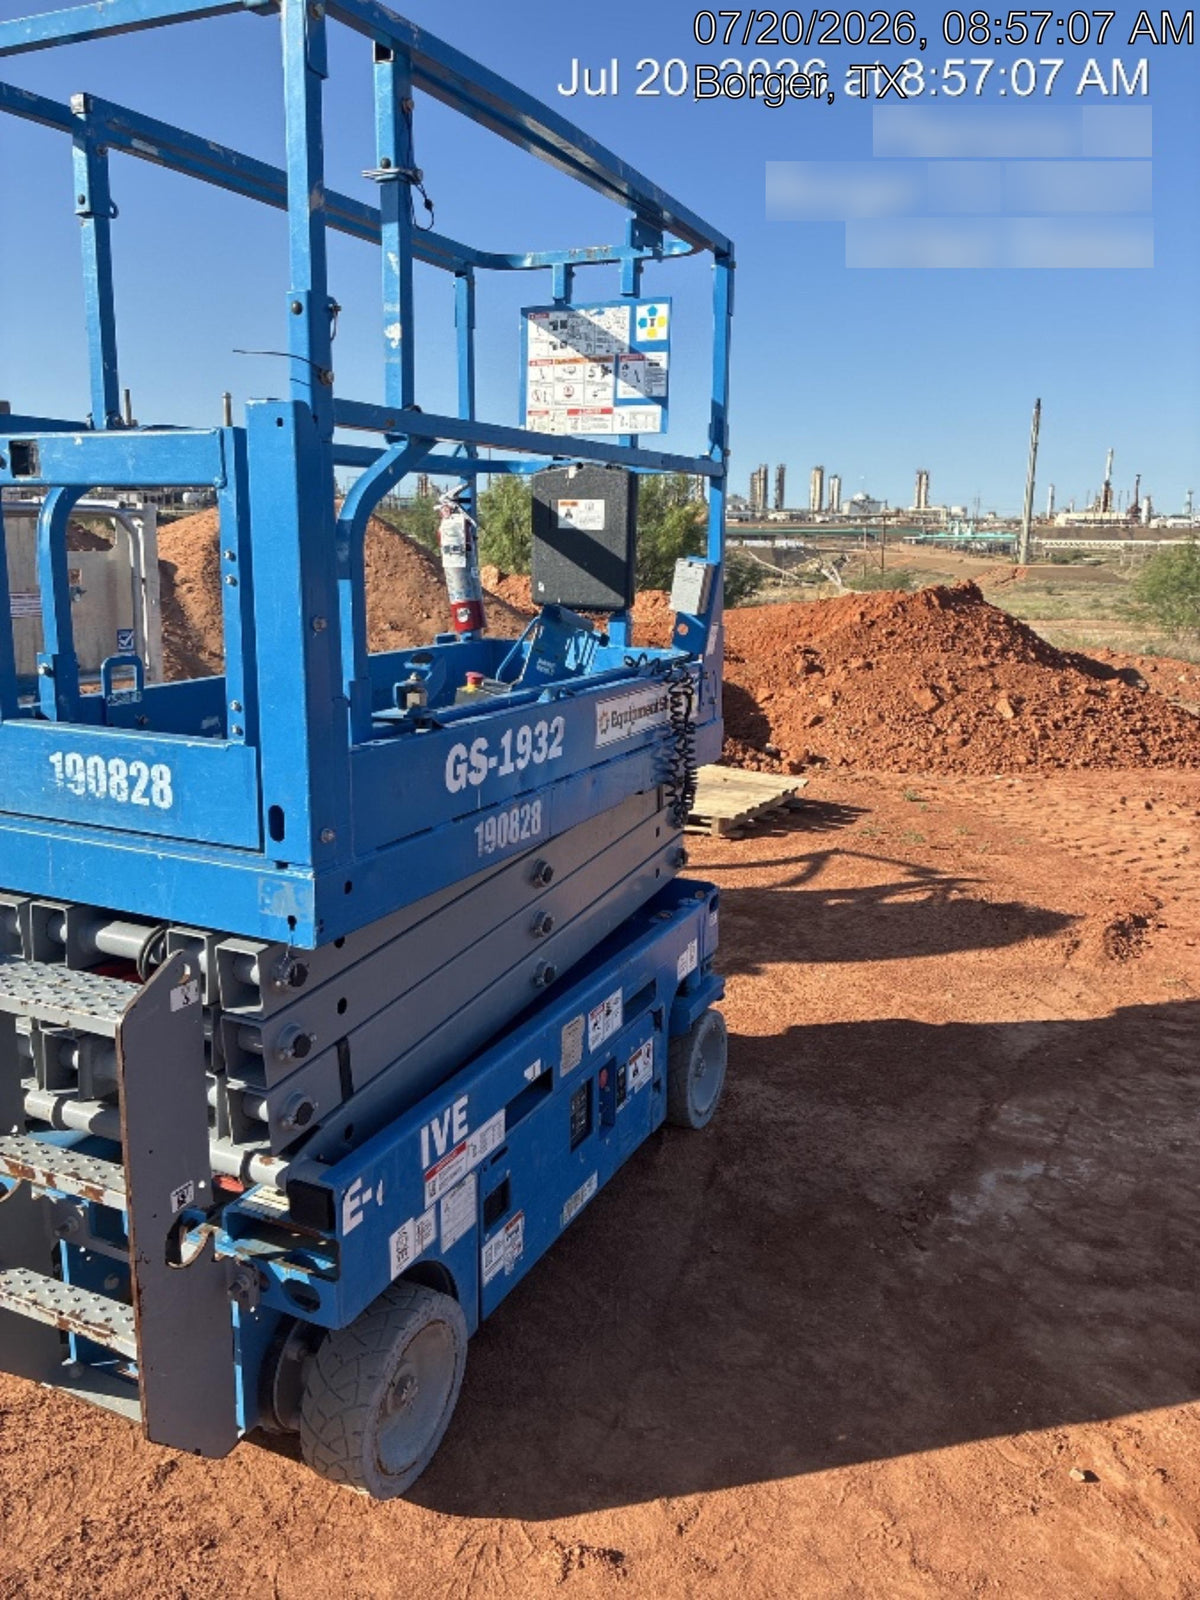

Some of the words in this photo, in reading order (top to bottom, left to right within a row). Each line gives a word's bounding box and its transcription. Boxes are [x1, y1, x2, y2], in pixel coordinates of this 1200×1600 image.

[49, 751, 173, 810] 190828
[445, 715, 565, 794] GS-1932
[474, 799, 542, 858] 190828
